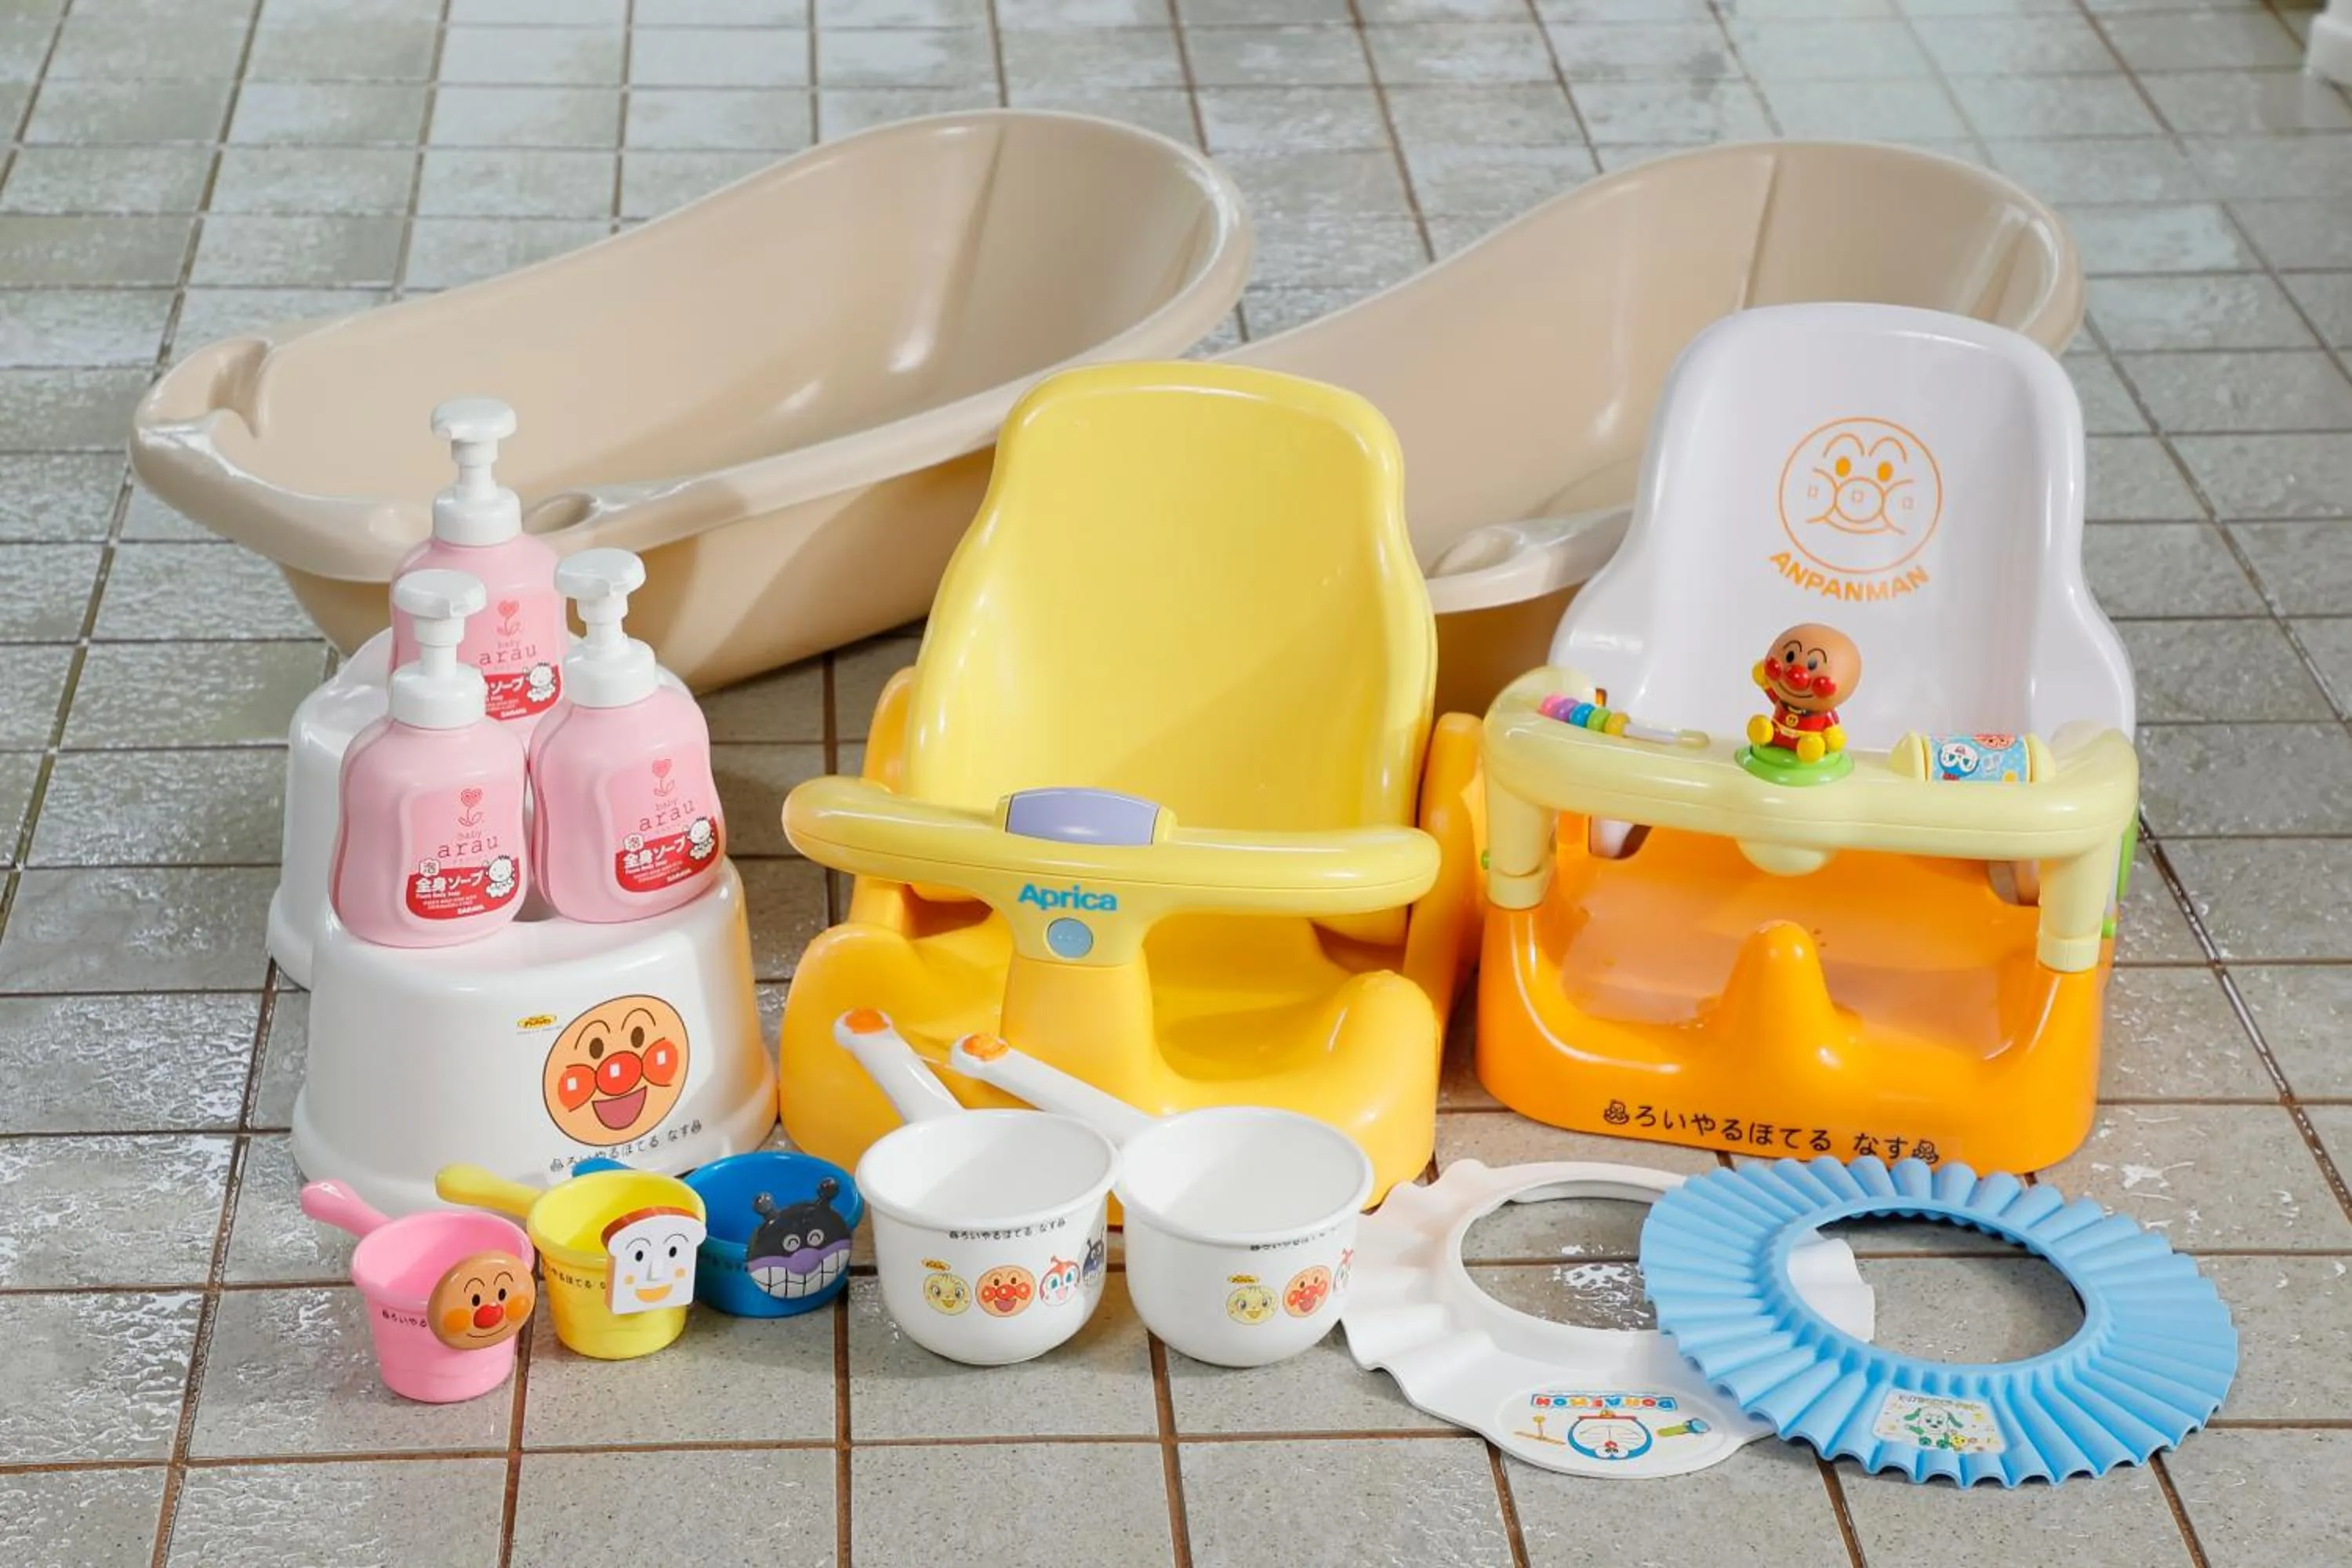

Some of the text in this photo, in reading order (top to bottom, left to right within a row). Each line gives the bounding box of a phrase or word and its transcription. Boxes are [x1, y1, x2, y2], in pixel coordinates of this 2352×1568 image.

[1769, 550, 1929, 602] ANPANMAN
[478, 644, 537, 666] arau
[485, 676, 525, 695] ソープ
[639, 800, 696, 831] arau
[437, 835, 499, 858] arau
[622, 835, 686, 869] 全身ソープ
[416, 869, 485, 893] 全身ソープ
[1017, 883, 1118, 911] Aprica
[1634, 1105, 1908, 1158] ろいやるほてる なす
